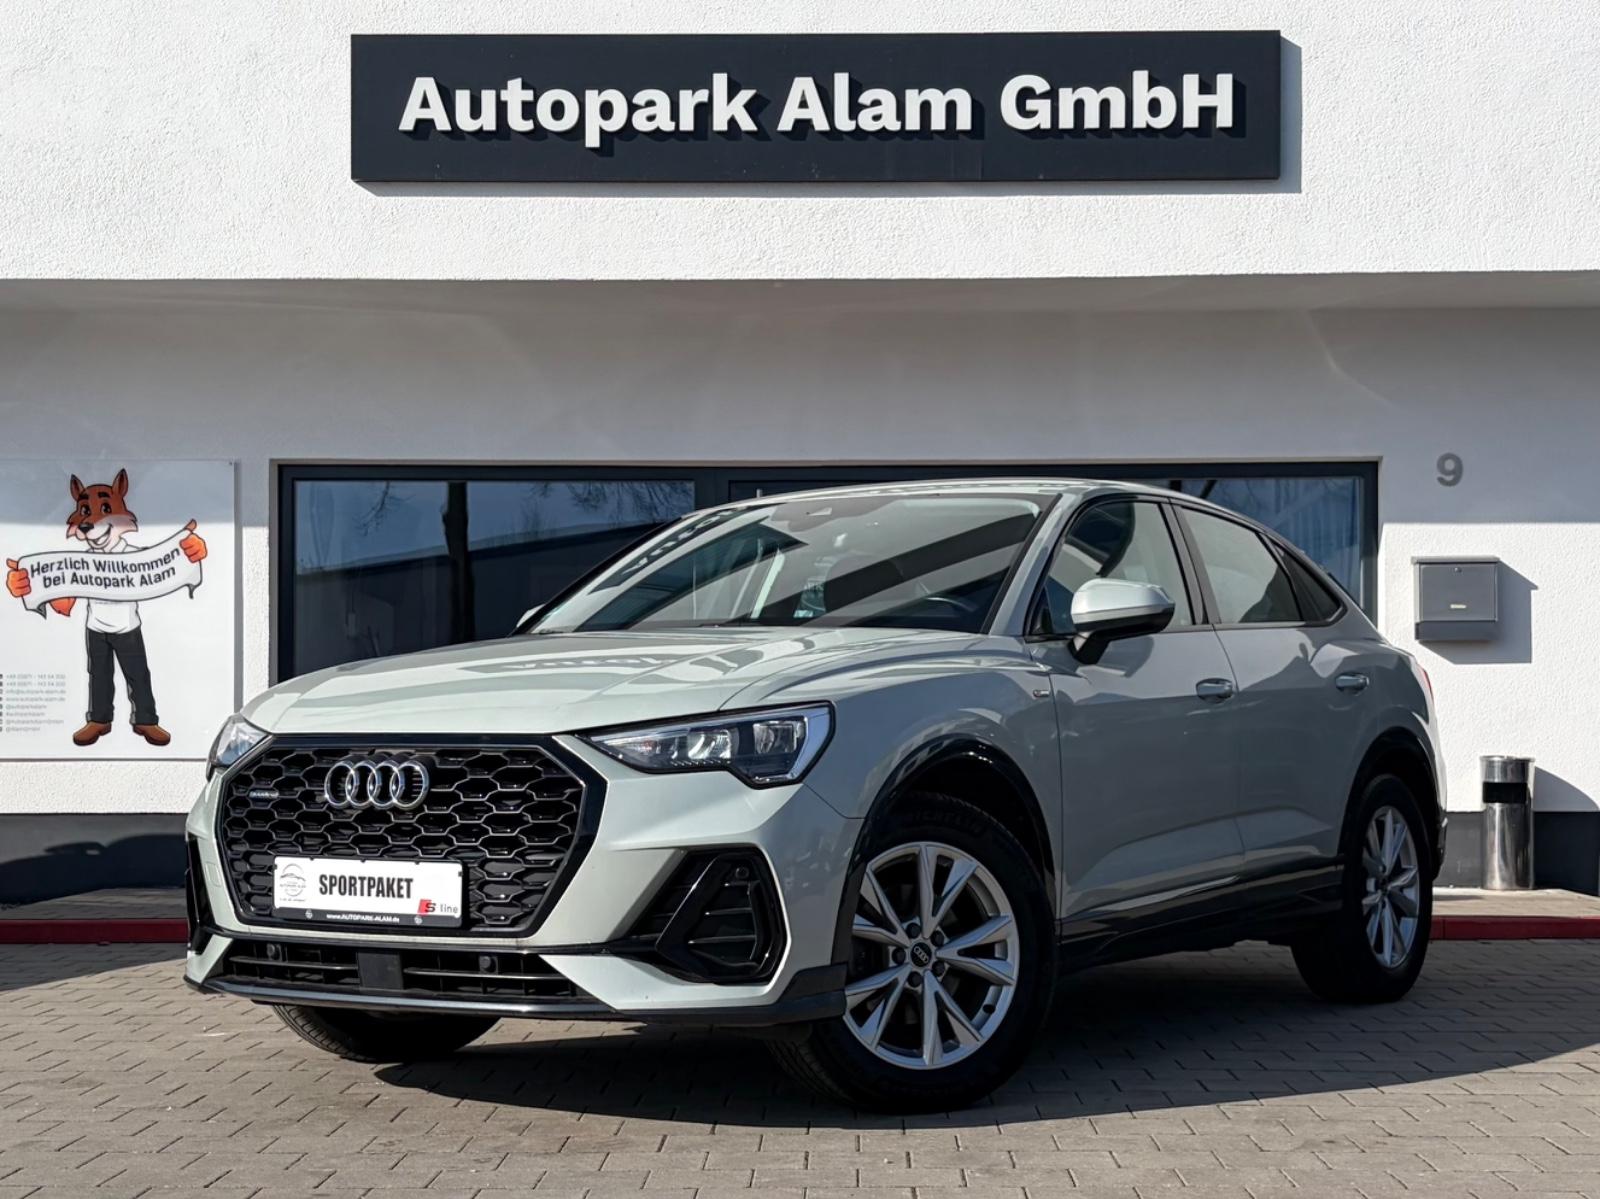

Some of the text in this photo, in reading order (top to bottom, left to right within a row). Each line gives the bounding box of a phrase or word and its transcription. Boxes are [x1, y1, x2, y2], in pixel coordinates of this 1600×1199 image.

[399, 69, 1235, 150] Autopark Alam GmbH
[1436, 452, 1463, 487] 9
[30, 548, 181, 578] Herzlich Willkommen
[42, 567, 177, 589] bei Autopark Alam
[319, 873, 414, 899] SPORTPAKET
[440, 904, 458, 914] line
